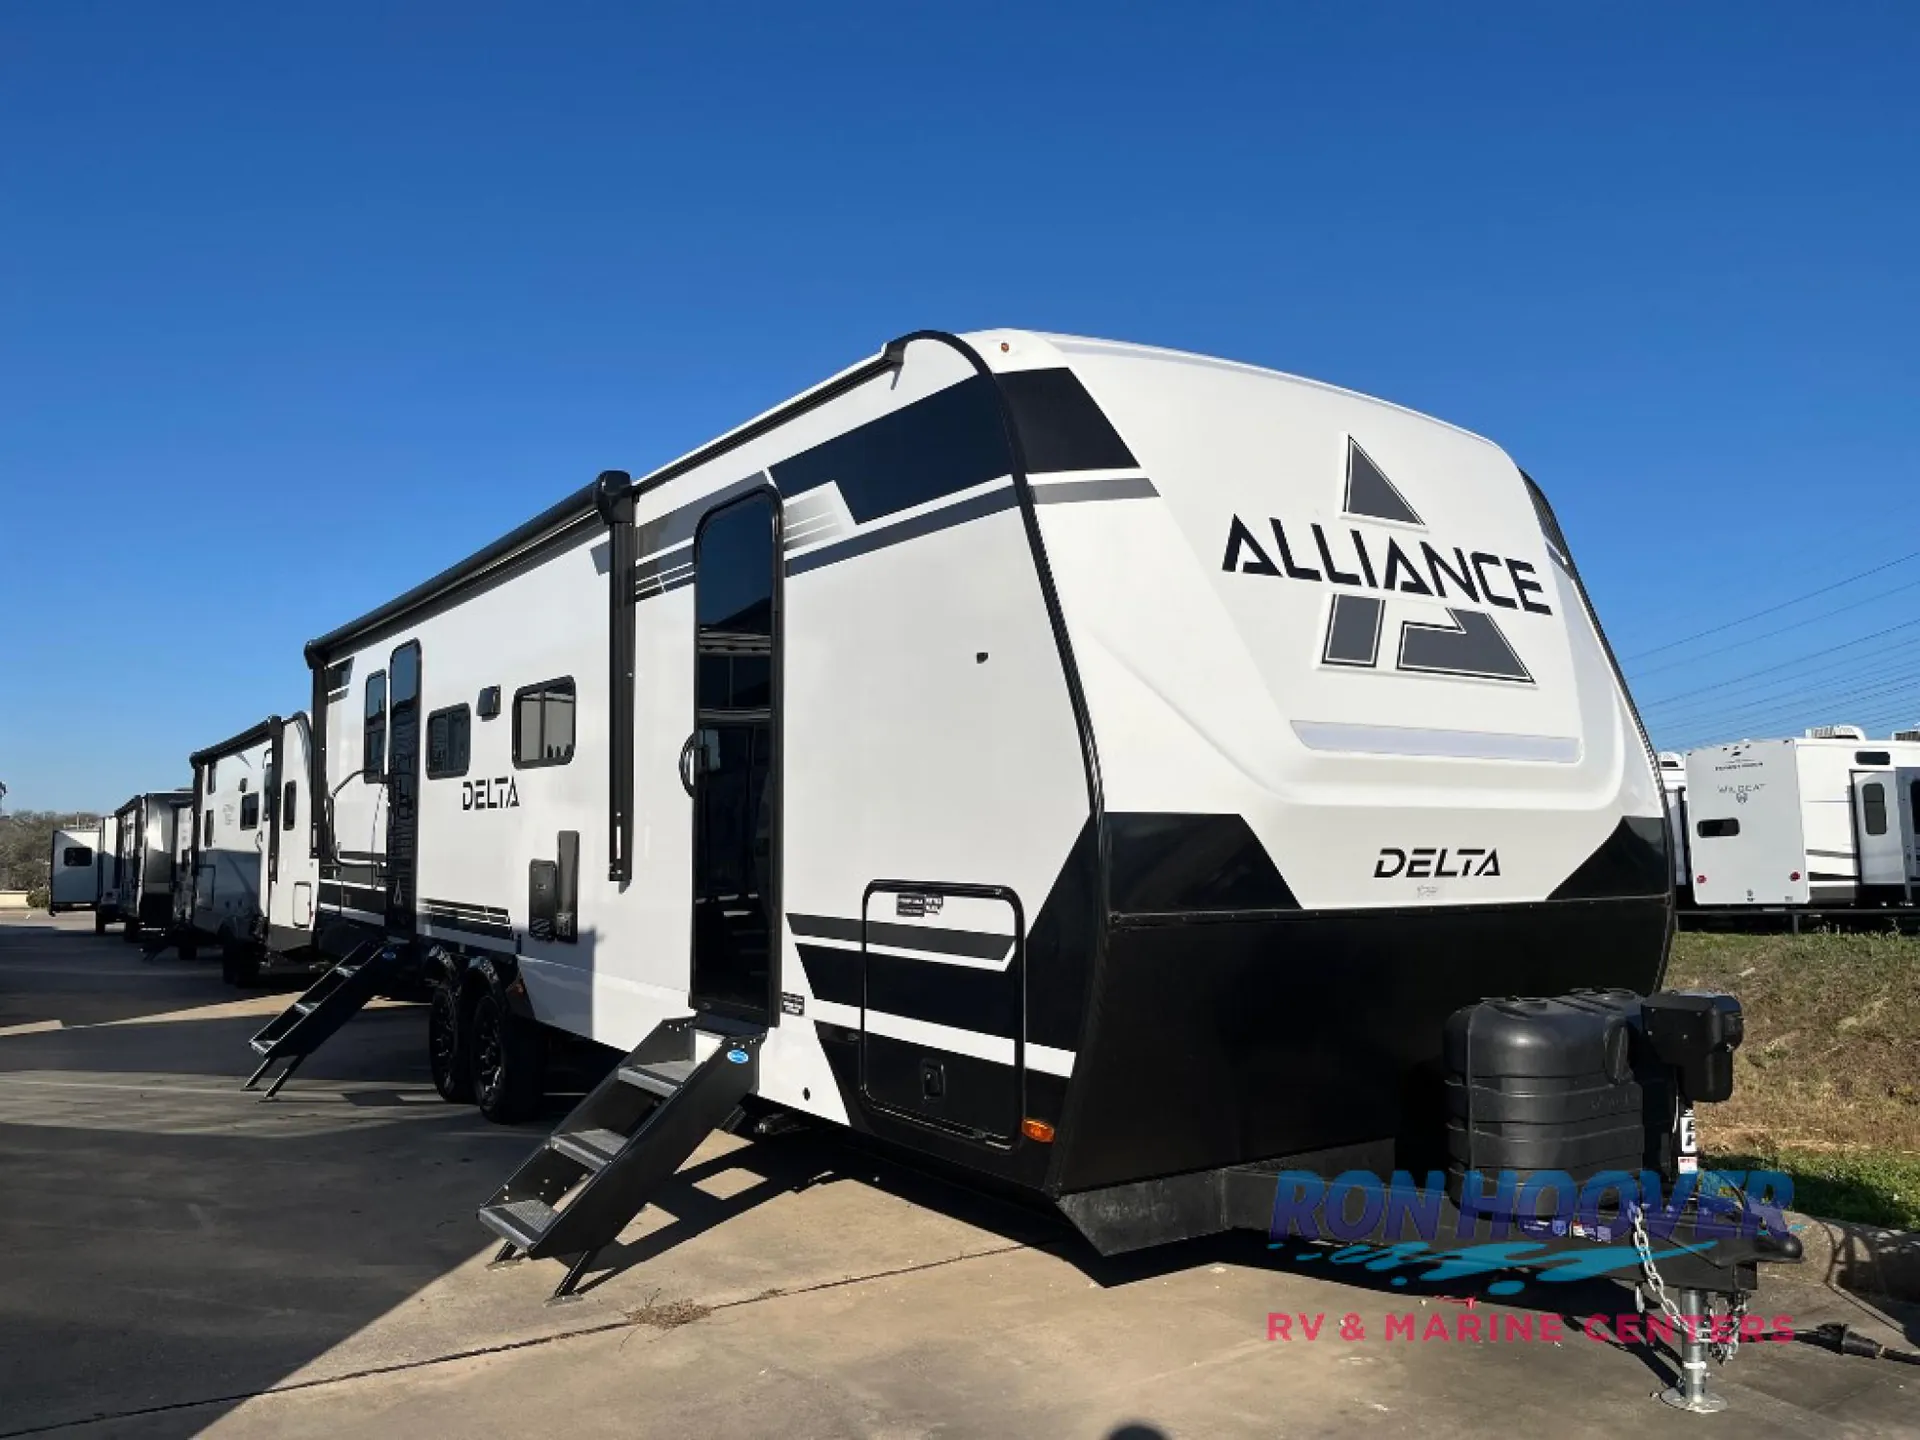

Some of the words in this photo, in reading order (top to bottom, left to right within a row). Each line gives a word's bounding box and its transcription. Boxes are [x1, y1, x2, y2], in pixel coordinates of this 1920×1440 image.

[1222, 514, 1553, 616] ALLIANCE
[462, 776, 520, 810] DELTA
[1374, 848, 1501, 878] DELTA
